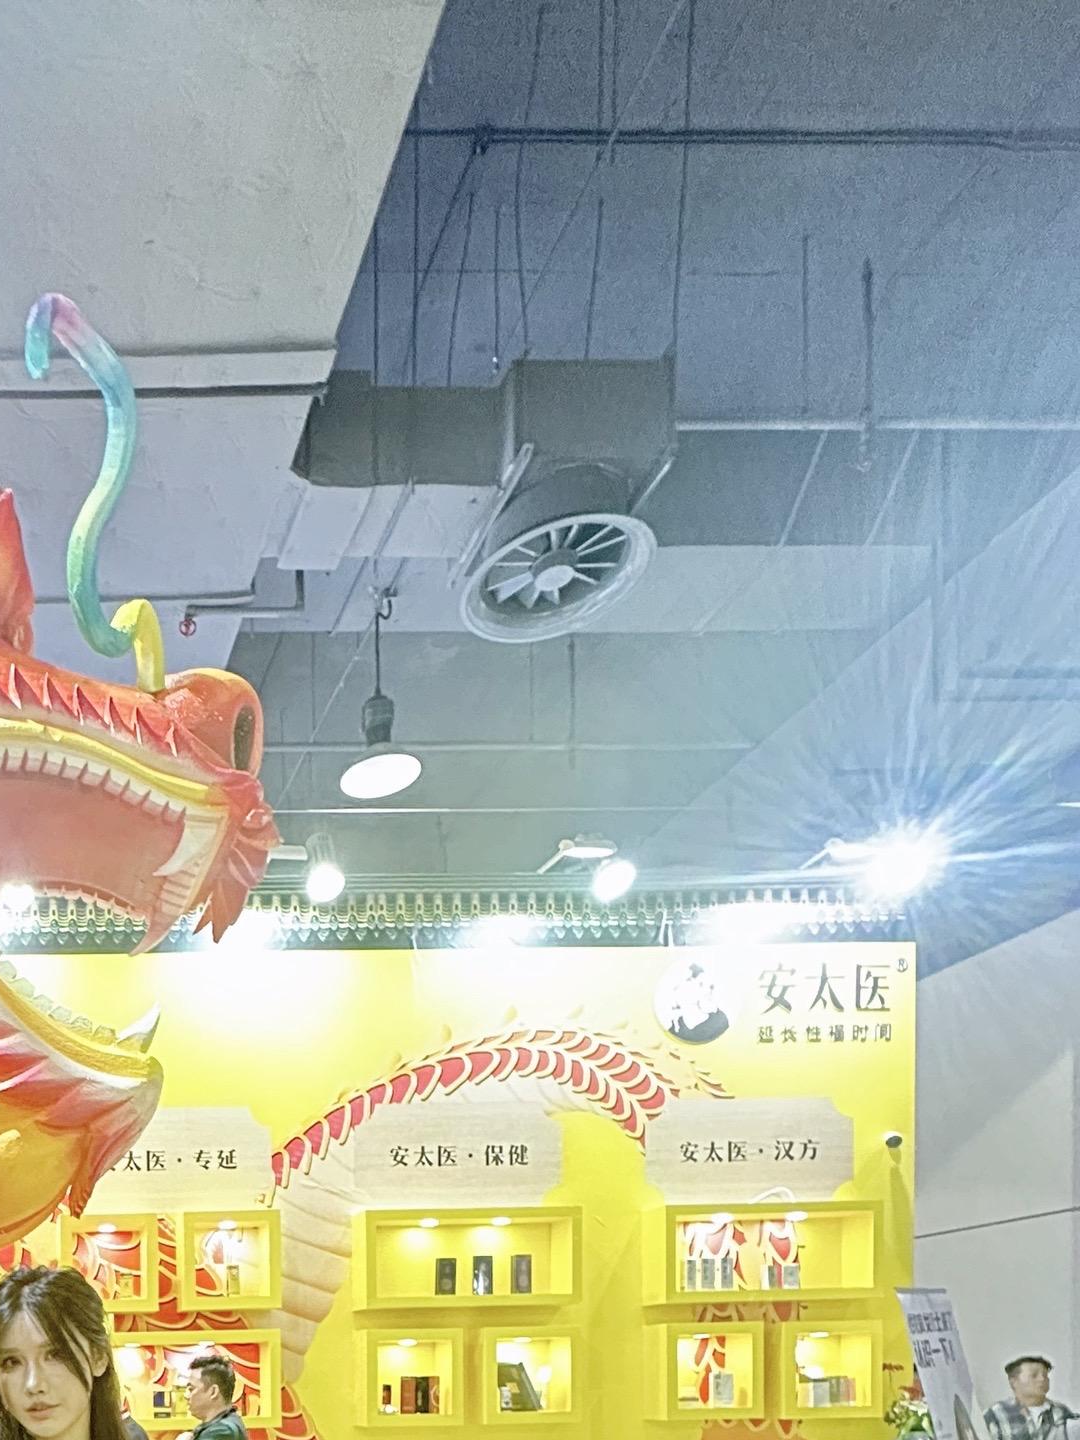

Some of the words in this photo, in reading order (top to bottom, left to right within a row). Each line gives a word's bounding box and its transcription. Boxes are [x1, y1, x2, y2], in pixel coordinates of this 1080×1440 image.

[759, 962, 891, 1015] 安太医
[109, 1149, 238, 1172] 太医·专延
[390, 1144, 529, 1168] 安太医·保健
[680, 1139, 821, 1163] 安太医·汉方
